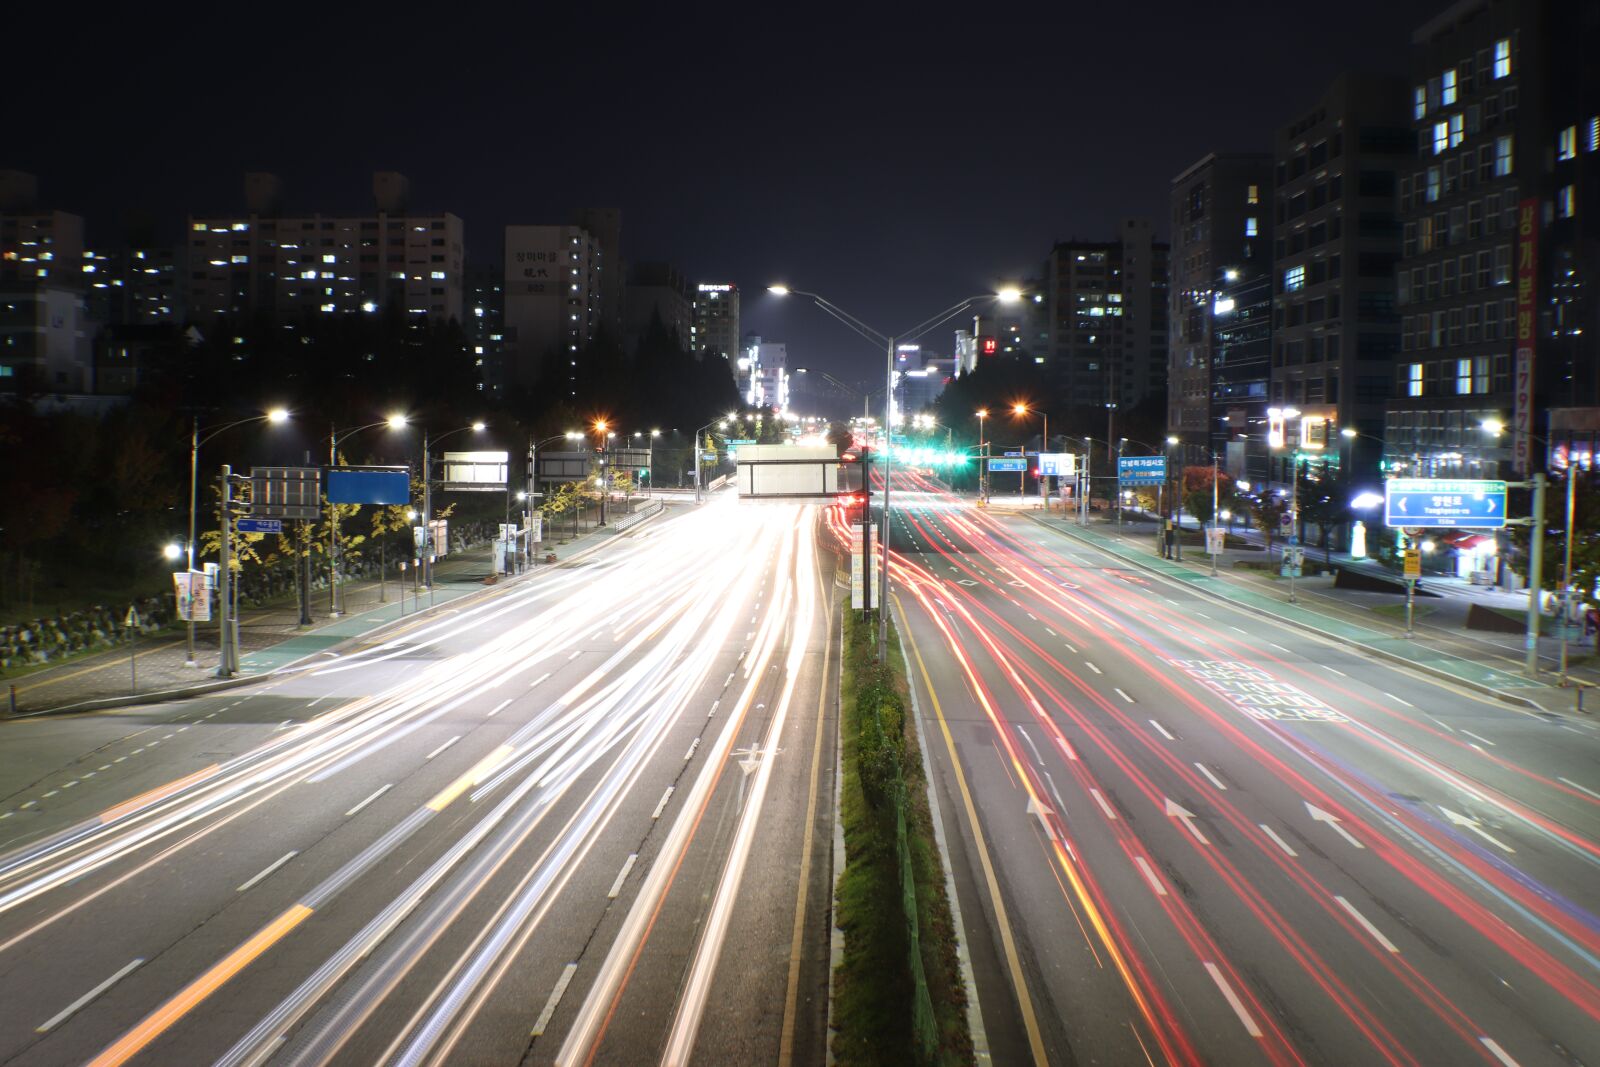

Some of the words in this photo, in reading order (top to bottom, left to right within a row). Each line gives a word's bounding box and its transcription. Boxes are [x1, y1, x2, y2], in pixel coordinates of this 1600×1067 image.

[515, 251, 557, 263] 장미마을
[1519, 205, 1534, 340] 상가분양
[1431, 495, 1463, 507] 양현로
